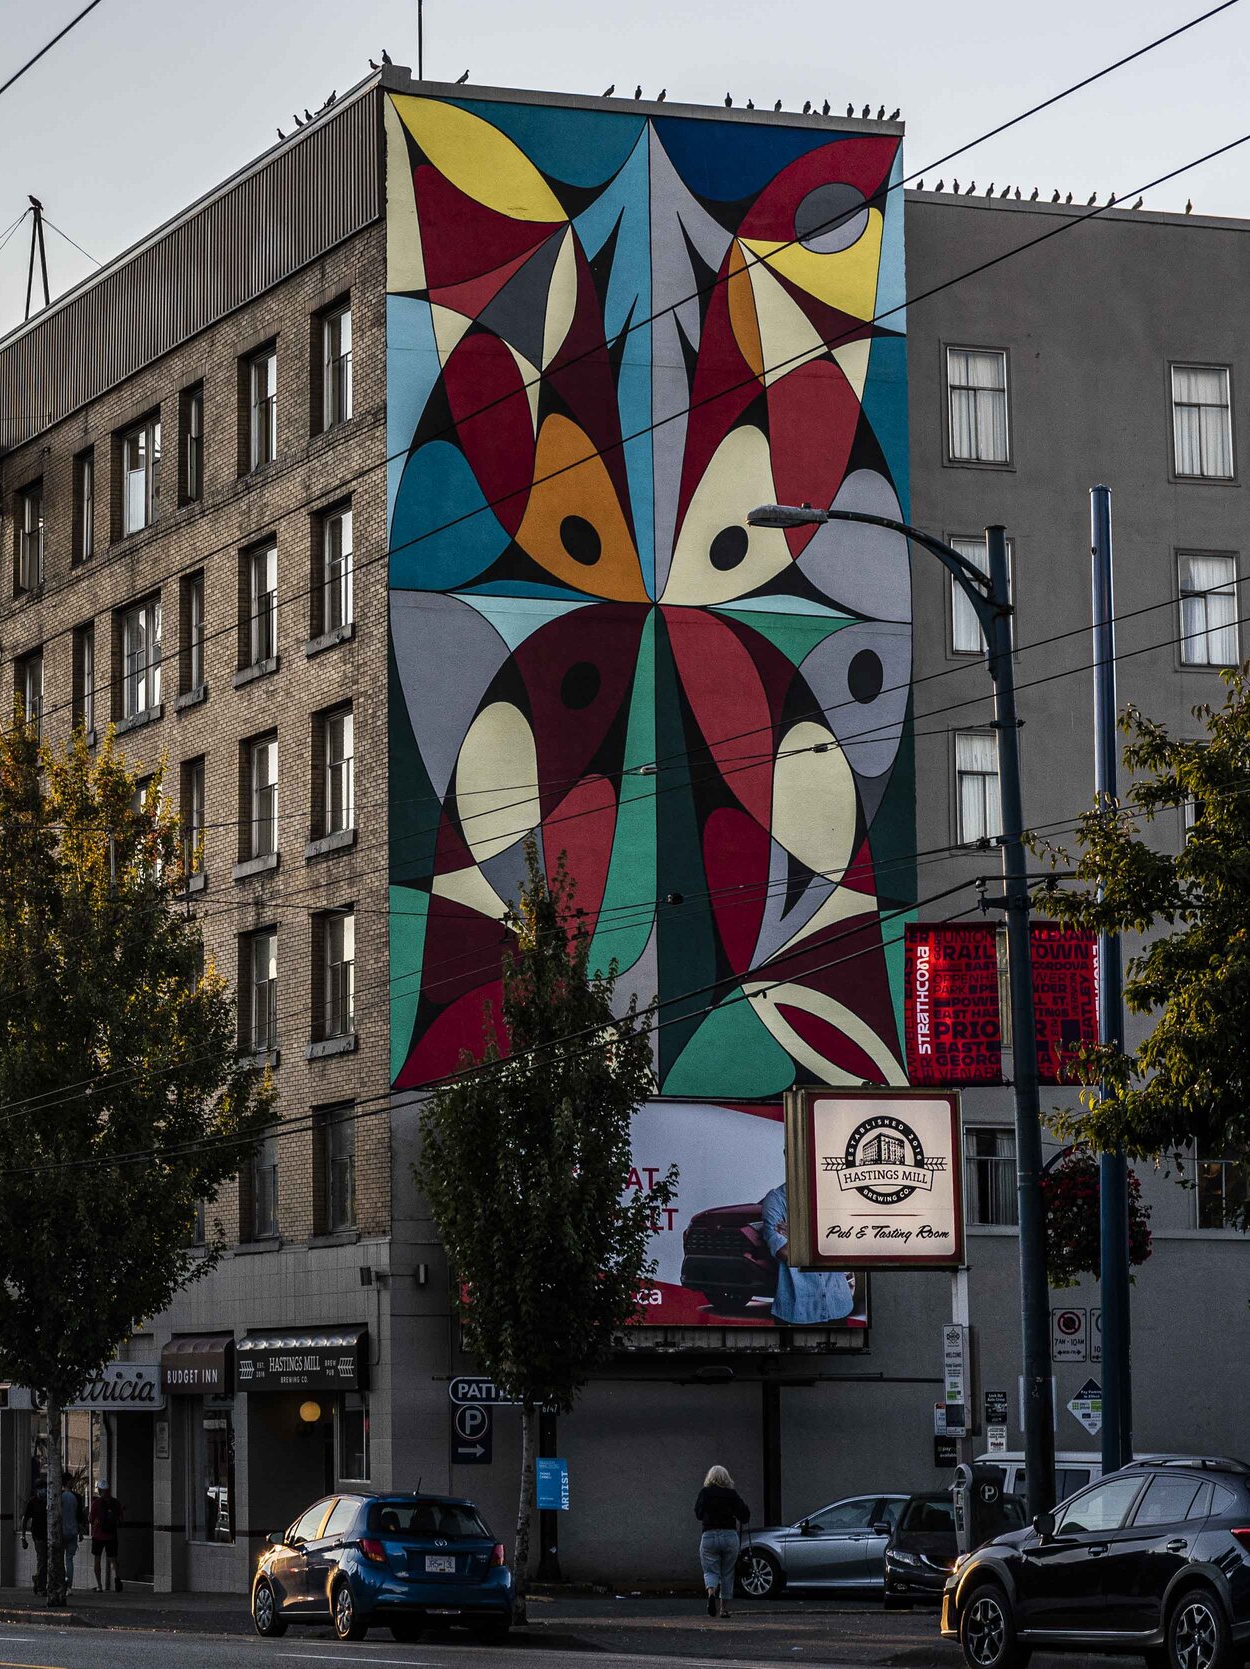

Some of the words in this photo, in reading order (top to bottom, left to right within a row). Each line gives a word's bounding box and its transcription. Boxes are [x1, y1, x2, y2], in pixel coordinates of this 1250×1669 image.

[1031, 961, 1089, 971] CORDOVA
[933, 1009, 968, 1019] EAST
[1079, 974, 1094, 1039] EATLEY
[935, 1041, 984, 1054] EAST
[848, 1119, 904, 1160] ESTABLISHED
[908, 1133, 922, 1160] 2016
[624, 1167, 660, 1190] AT
[844, 1170, 899, 1184] HASTINGS
[902, 1171, 928, 1184] MILL
[863, 1189, 897, 1202] BREWING
[899, 1188, 911, 1198] CO.
[826, 1225, 855, 1239] Pub
[855, 1225, 869, 1239] &
[871, 1225, 913, 1243] Tasting
[915, 1224, 950, 1239] Room
[269, 1356, 303, 1372] HASTINGS
[303, 1355, 321, 1371] MILL
[324, 1359, 337, 1367] BREW
[167, 1369, 198, 1384] BUDGET
[202, 1368, 218, 1383] INN
[280, 1376, 300, 1384] BREWING
[465, 1410, 482, 1434] P
[561, 1471, 570, 1511] ARTIST
